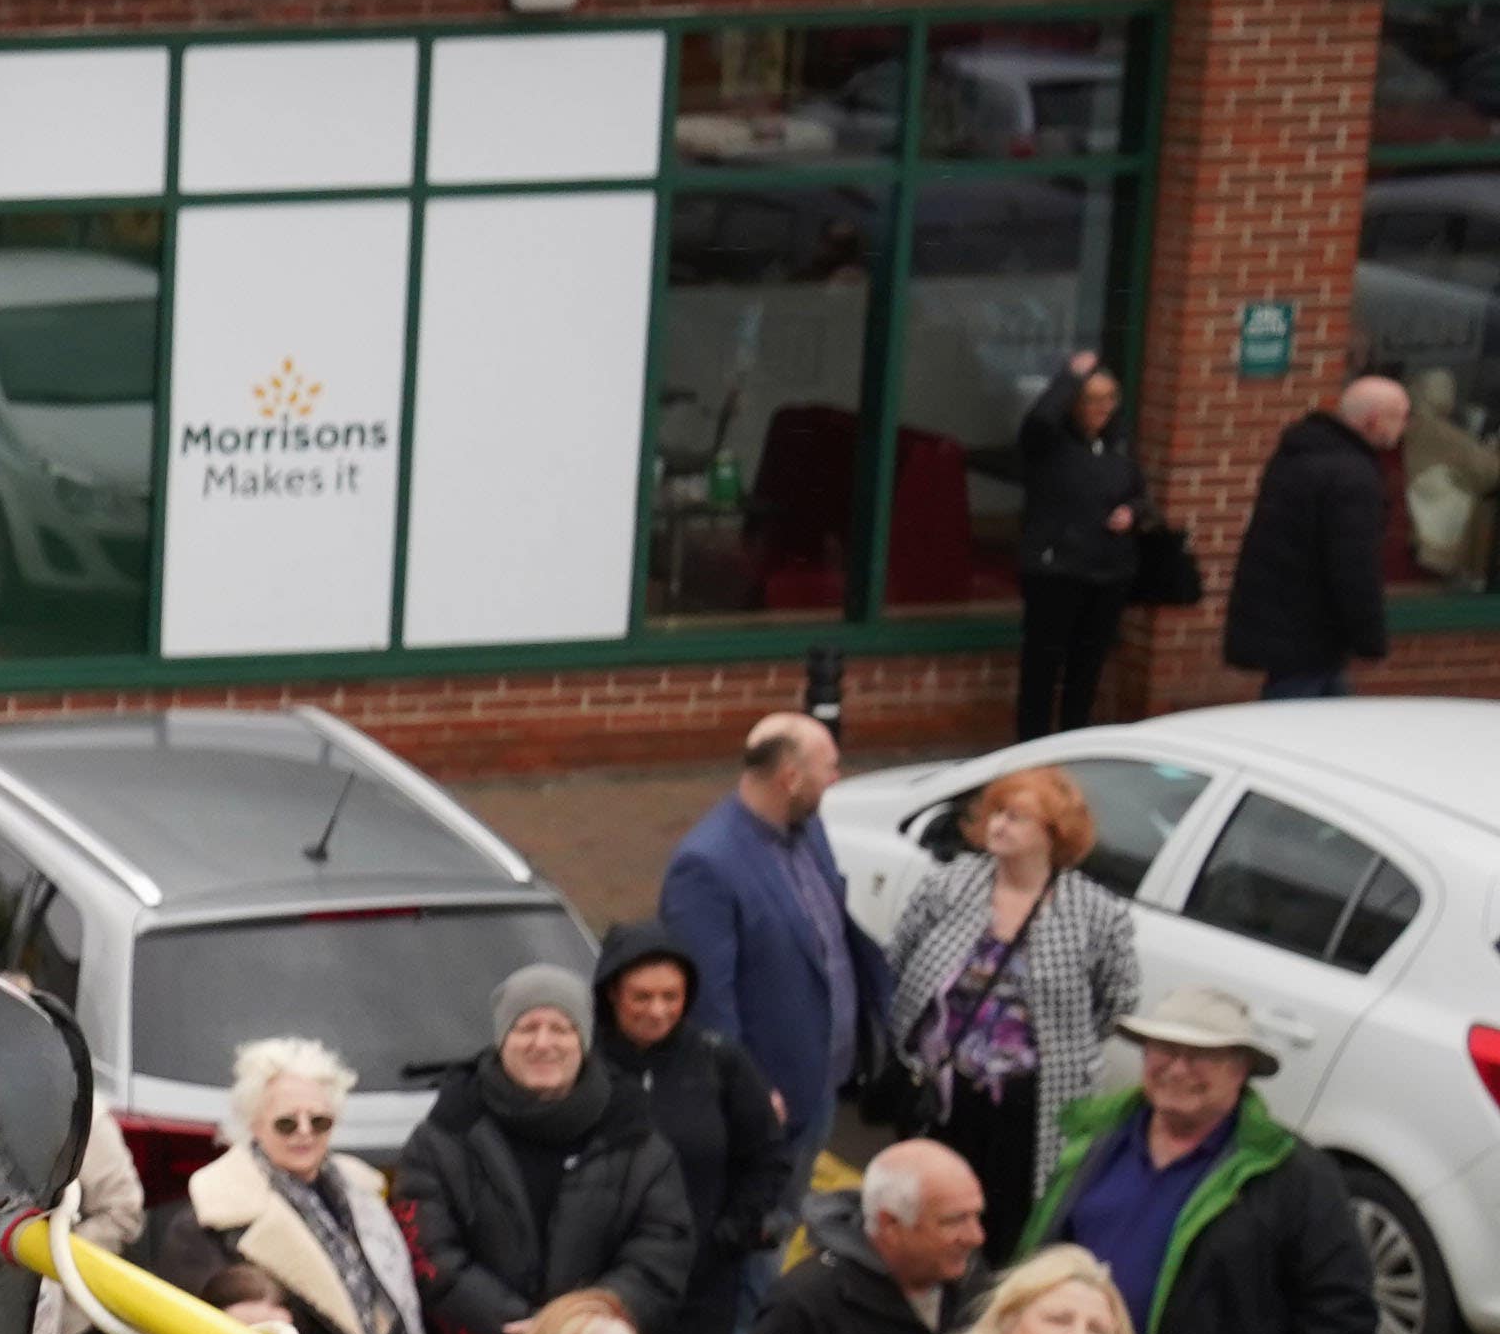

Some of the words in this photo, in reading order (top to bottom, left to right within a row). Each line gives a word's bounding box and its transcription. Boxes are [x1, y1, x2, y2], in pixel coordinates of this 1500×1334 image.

[180, 413, 389, 455] Morrisons
[202, 464, 325, 498] Makes
[335, 462, 360, 493] it
